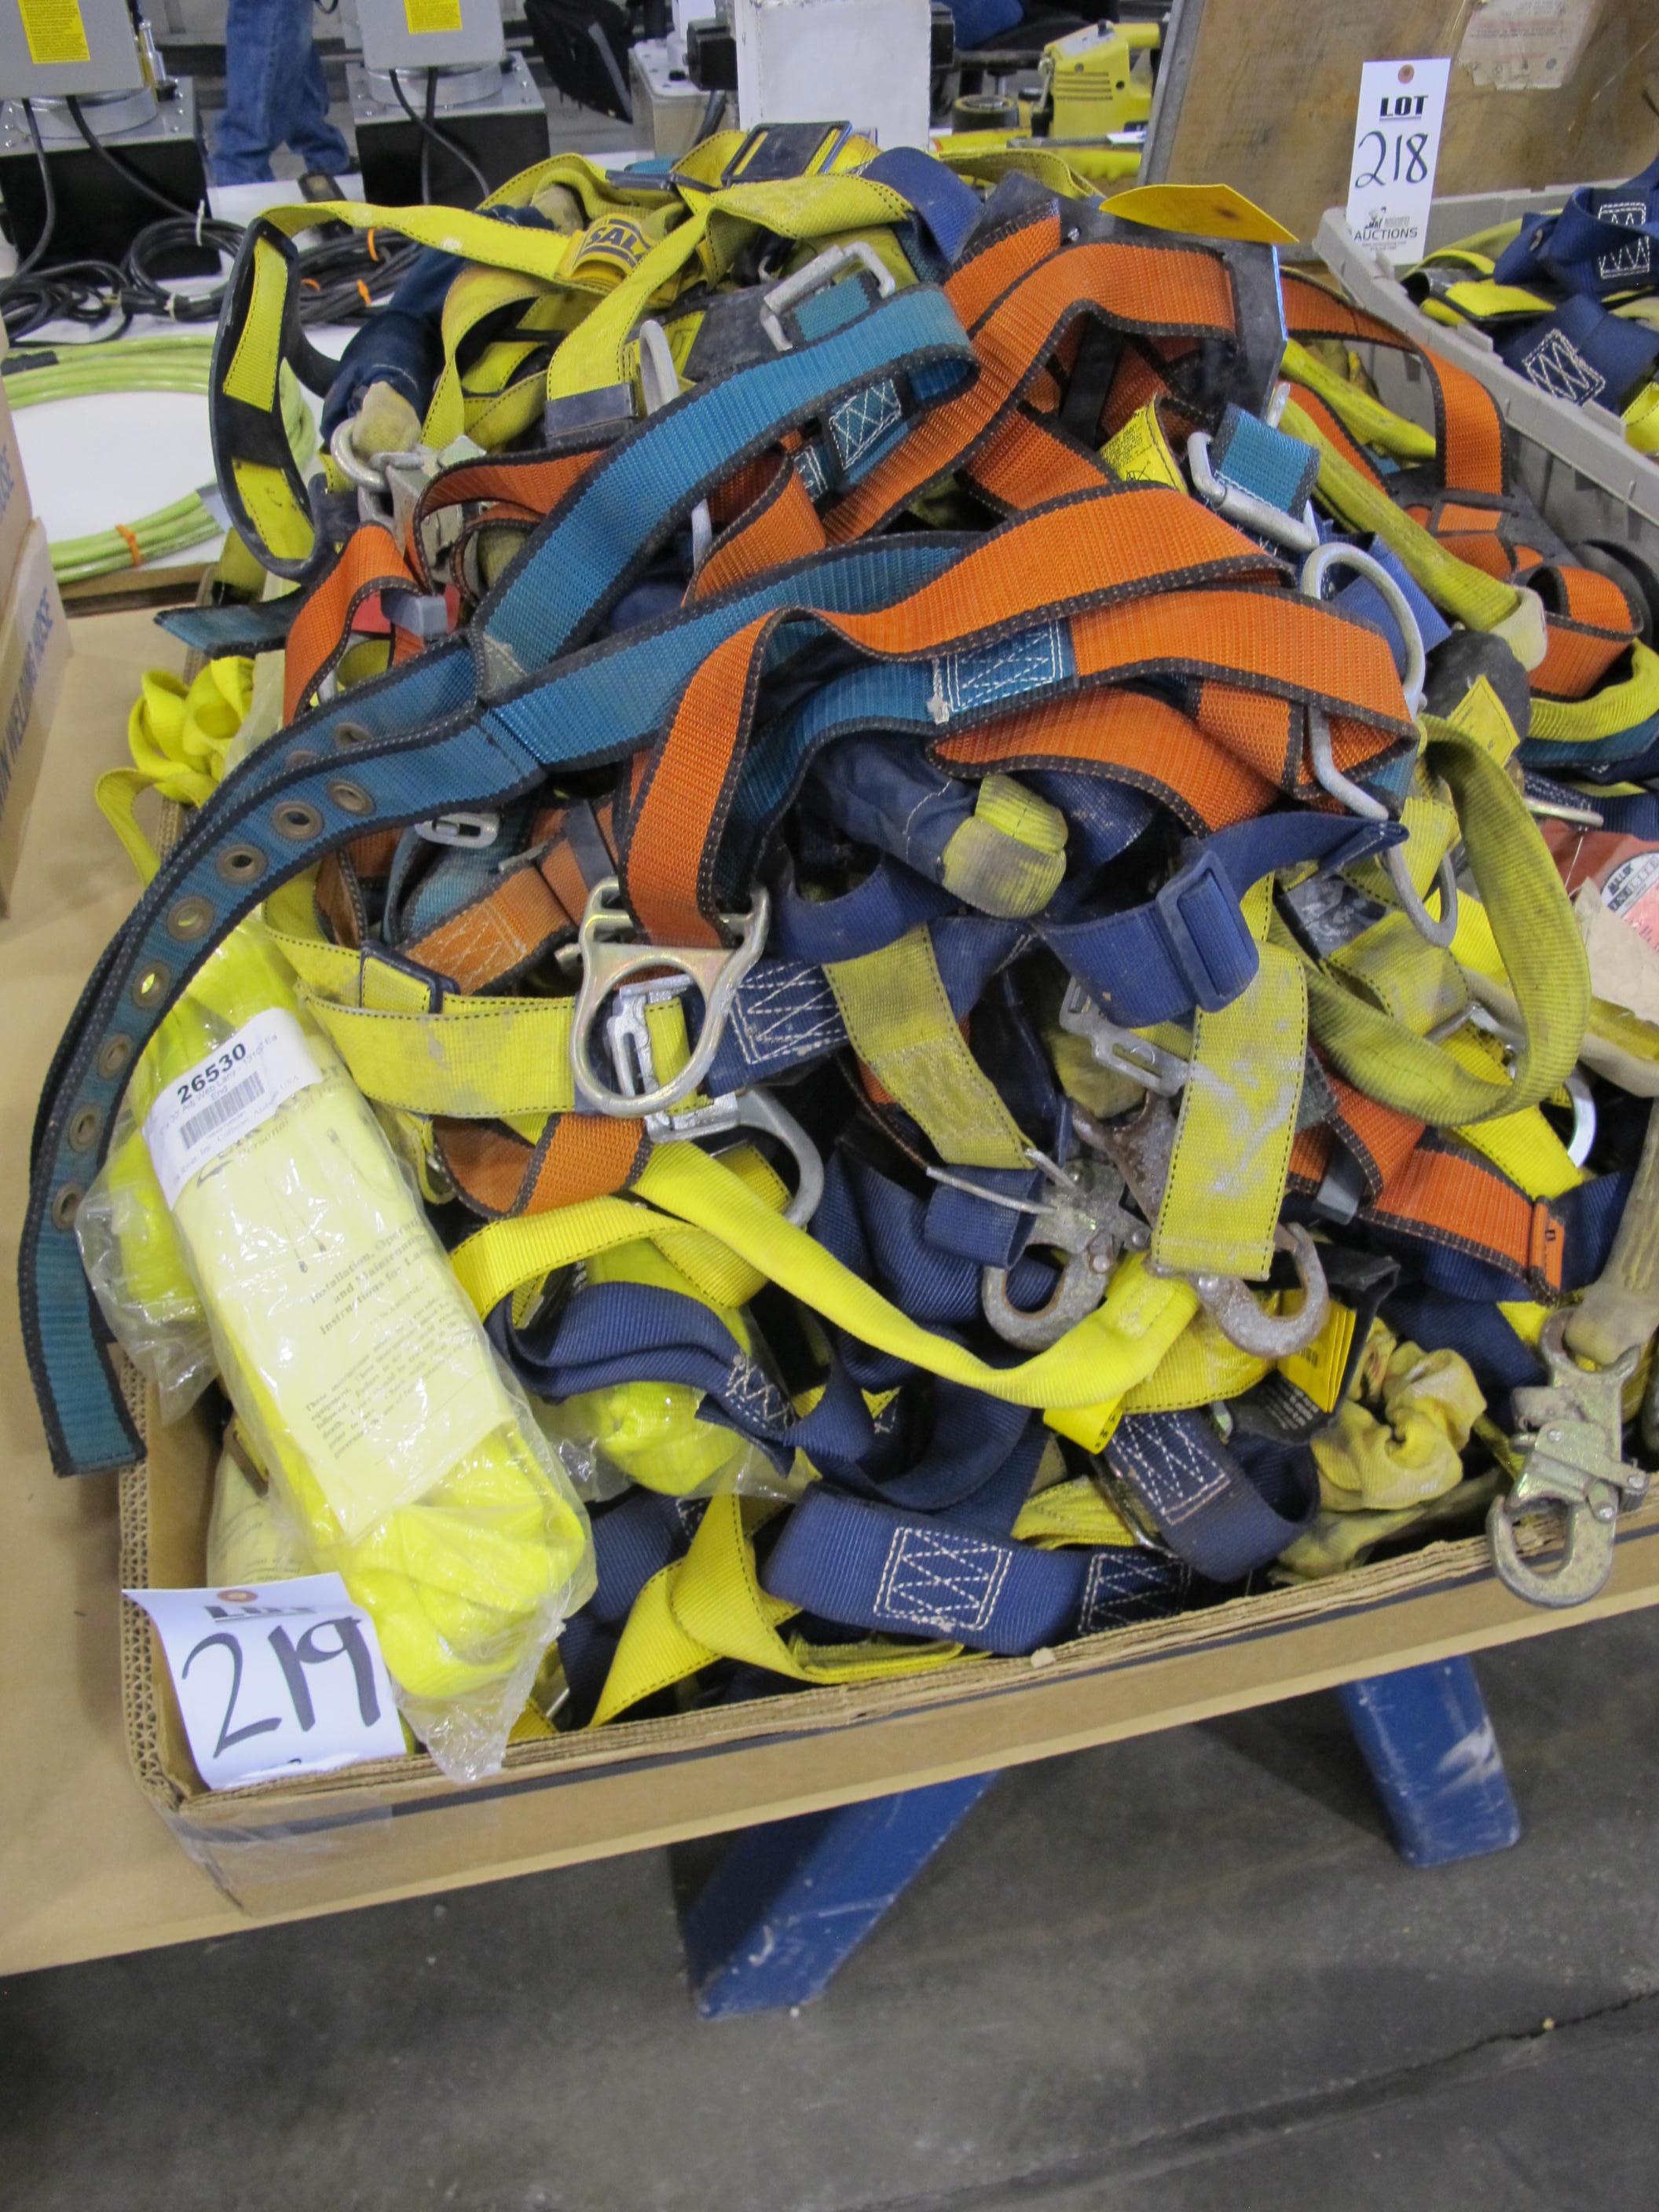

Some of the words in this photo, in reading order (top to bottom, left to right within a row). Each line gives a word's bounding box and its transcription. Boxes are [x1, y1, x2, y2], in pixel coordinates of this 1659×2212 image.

[1379, 95, 1429, 117] LOT
[1354, 130, 1429, 189] 218
[587, 225, 643, 262] SAL
[1354, 227, 1418, 242] AUCTIONS
[177, 1043, 247, 1105] 26530
[334, 1282, 354, 1304] and
[181, 1616, 381, 1759] 219
